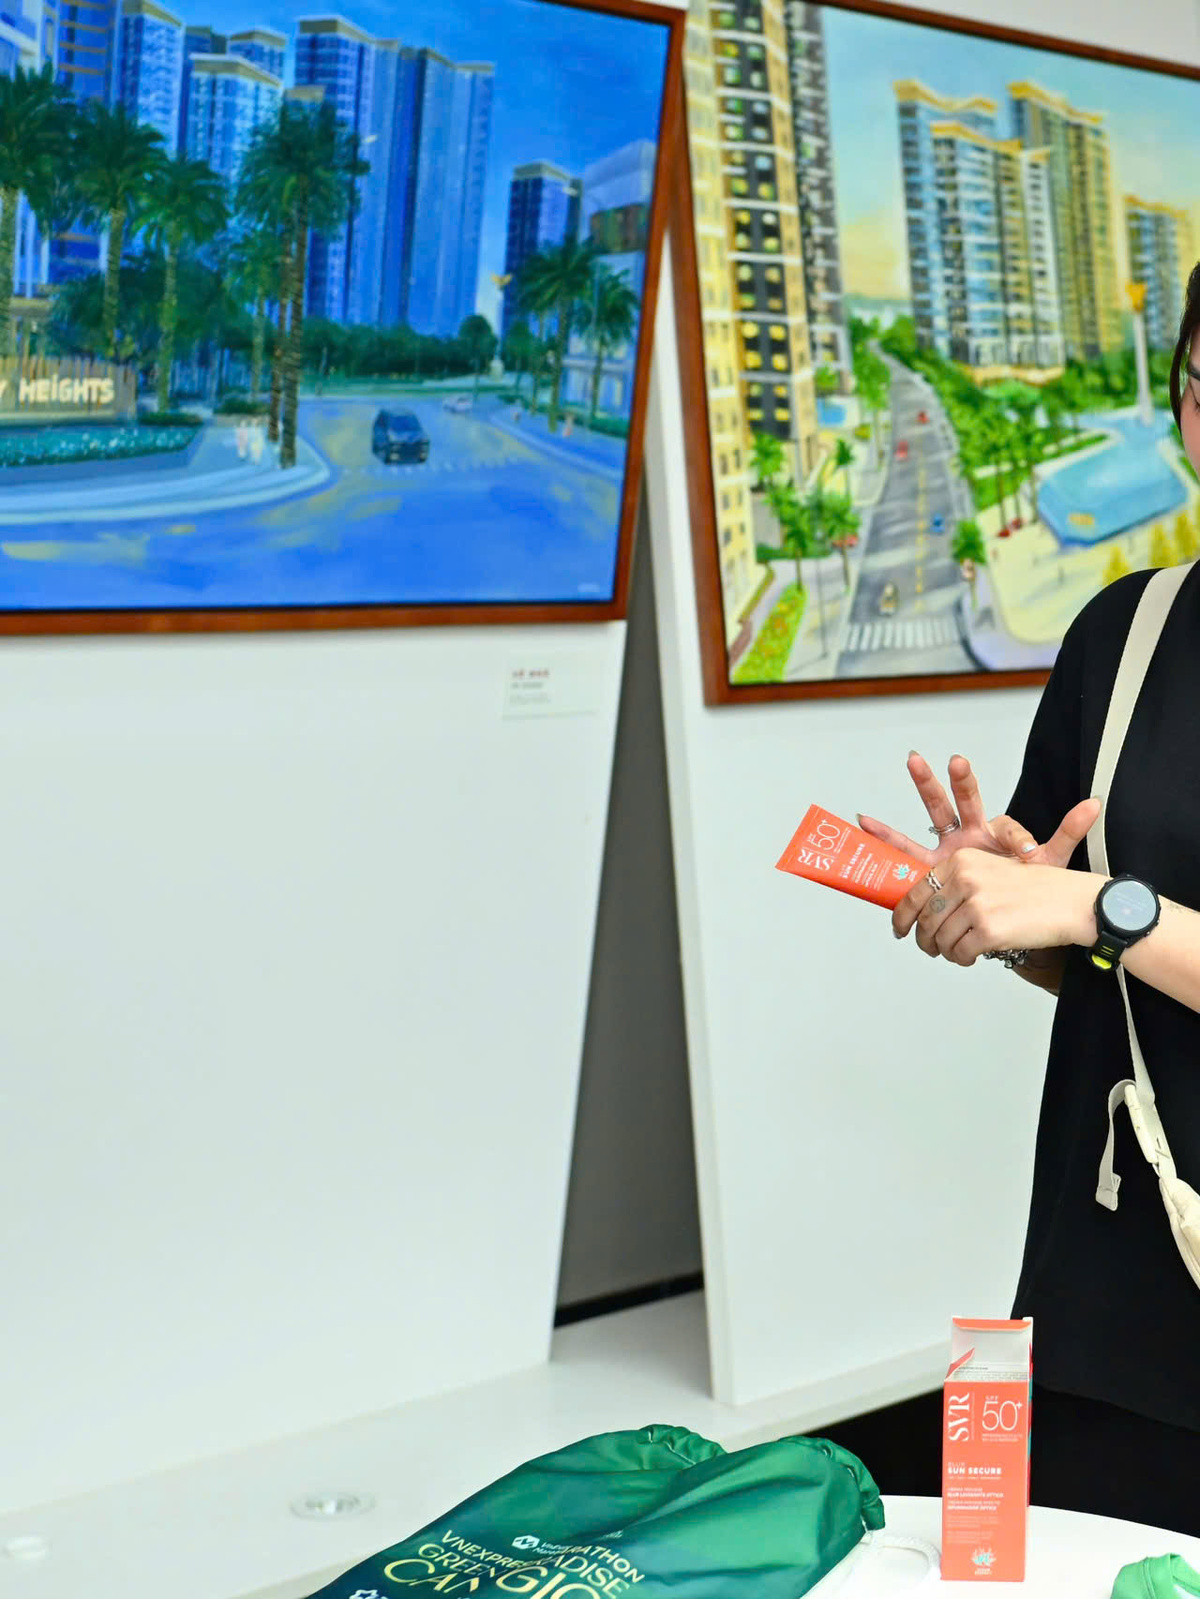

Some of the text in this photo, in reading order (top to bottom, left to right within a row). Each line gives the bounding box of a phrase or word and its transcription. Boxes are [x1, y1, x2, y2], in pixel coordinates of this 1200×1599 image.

[797, 849, 834, 870] SVR
[948, 1392, 970, 1442] SVR
[981, 1400, 1023, 1431] 50+
[948, 1467, 1002, 1475] SUN SECURE
